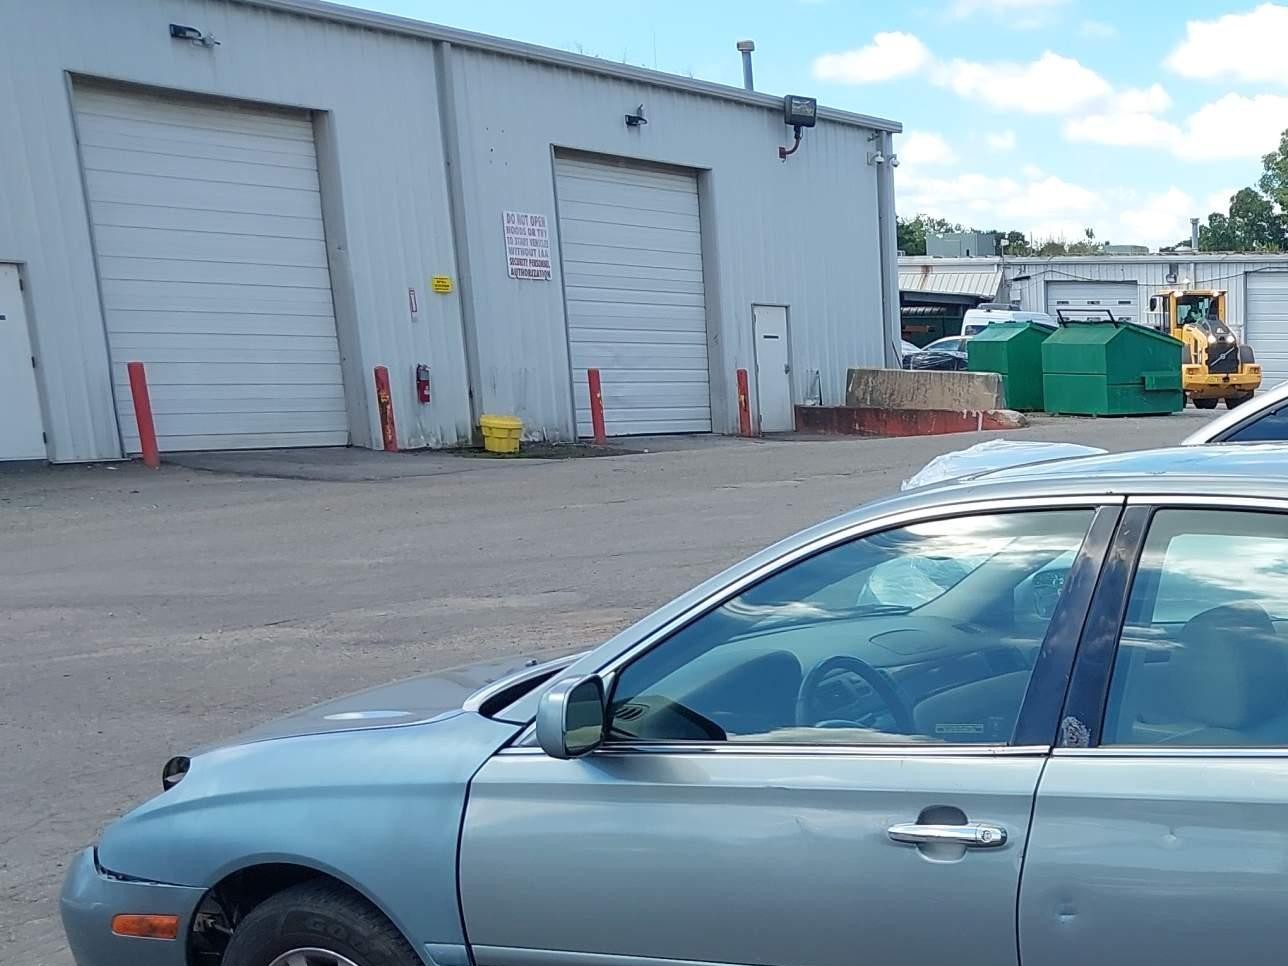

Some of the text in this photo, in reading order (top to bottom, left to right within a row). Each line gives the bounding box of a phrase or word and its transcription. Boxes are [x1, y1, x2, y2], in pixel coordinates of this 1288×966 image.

[506, 213, 545, 228] DO NOT OPEN
[528, 228, 536, 237] OR
[507, 236, 514, 245] TO
[508, 247, 536, 257] WITHOUT
[511, 268, 551, 277] AUTHORIZATION
